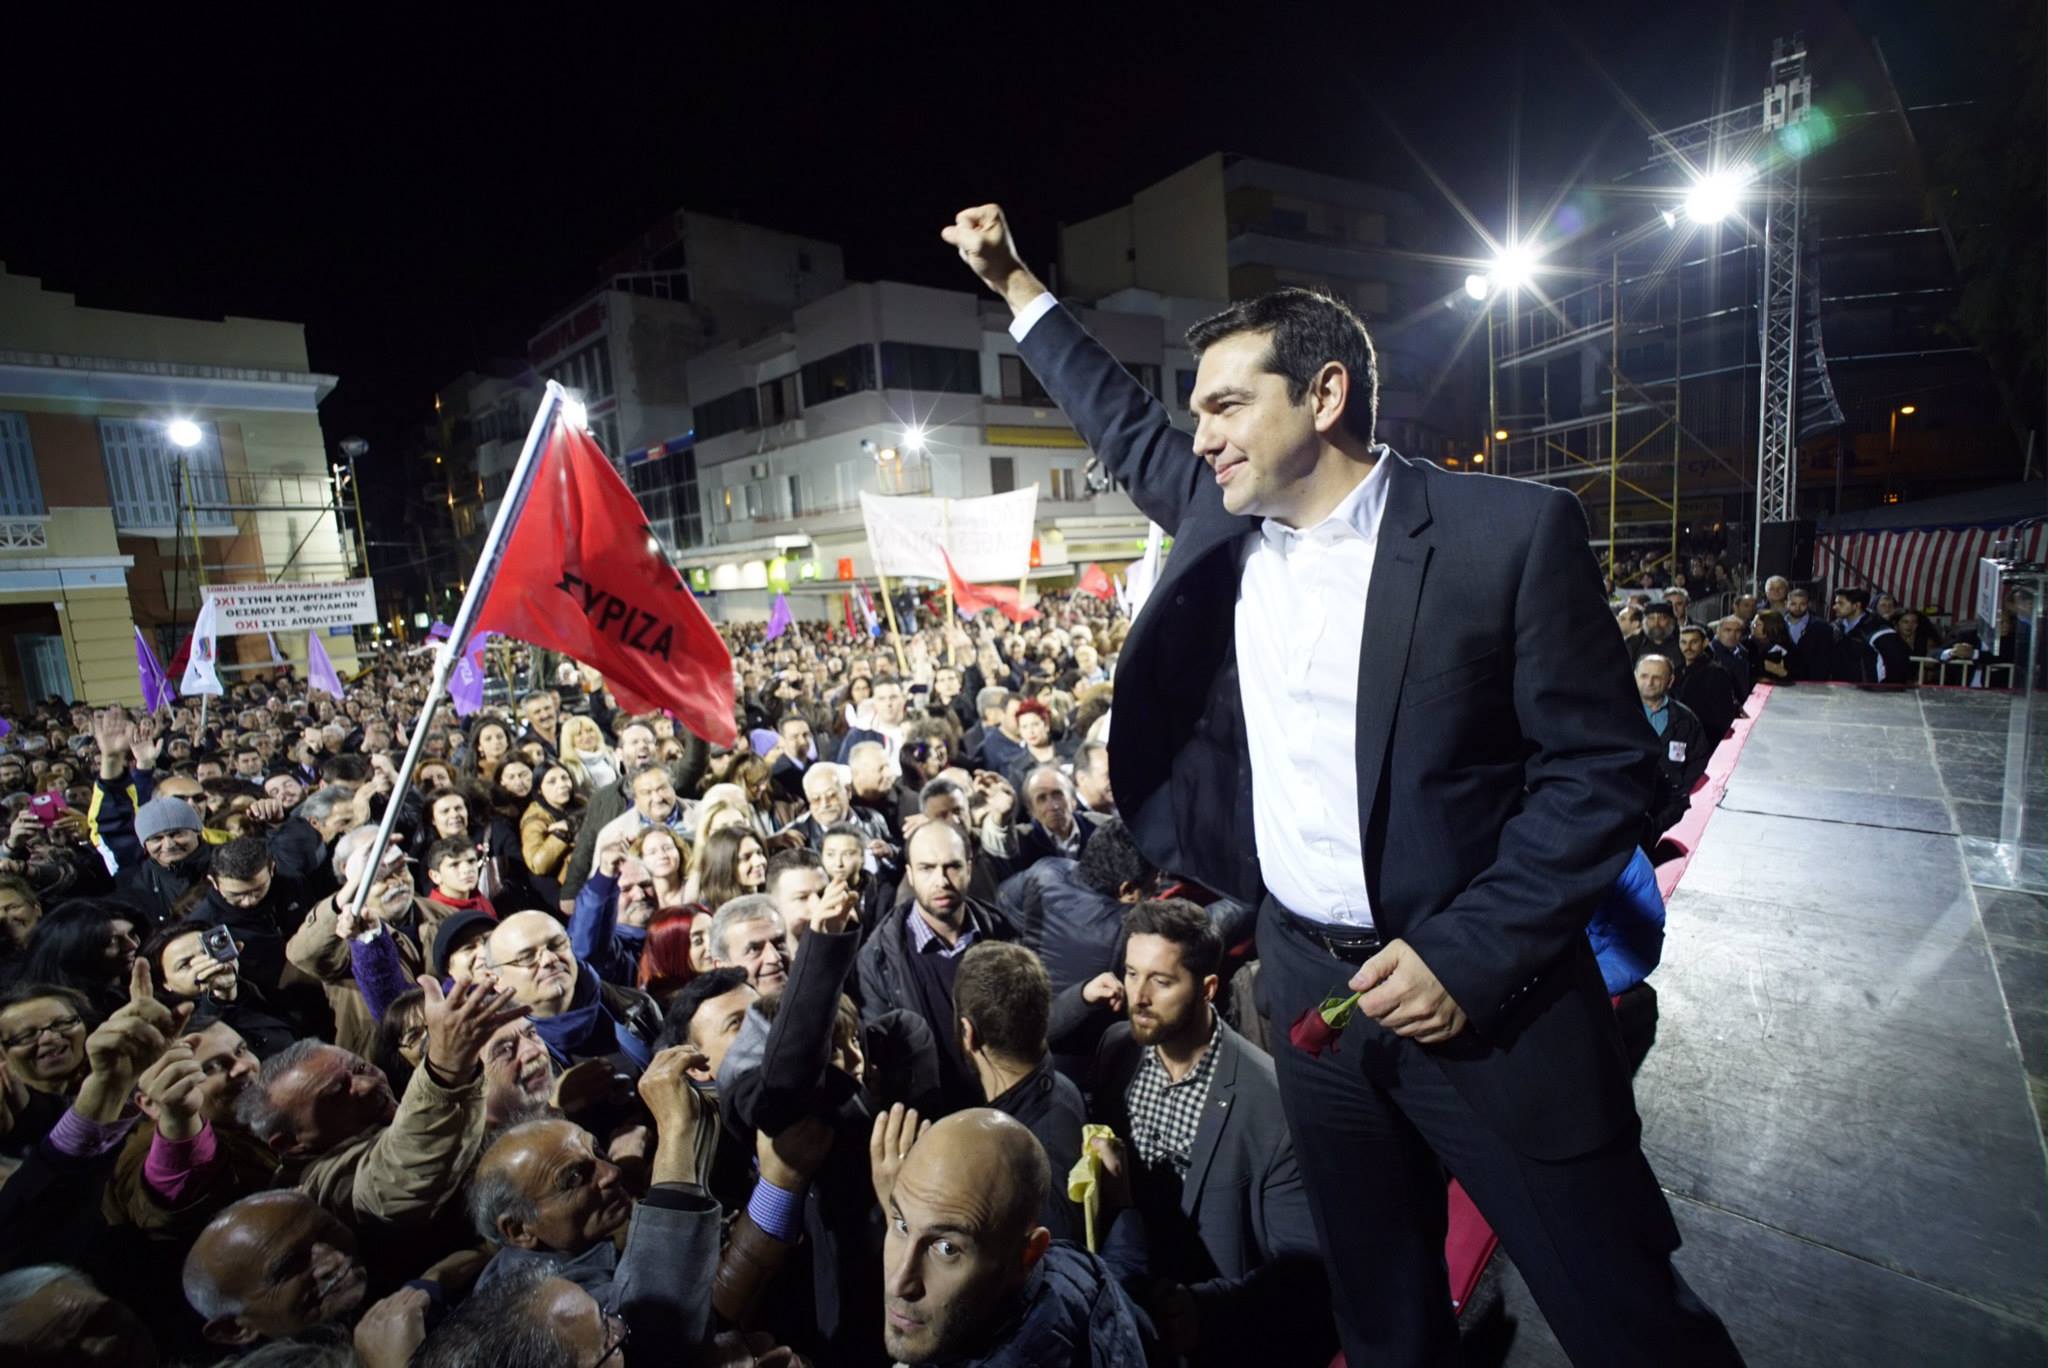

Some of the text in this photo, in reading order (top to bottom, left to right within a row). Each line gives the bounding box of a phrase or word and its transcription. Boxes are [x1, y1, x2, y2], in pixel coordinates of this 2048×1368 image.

[239, 595, 272, 605] ΣΤΗΝ
[275, 591, 342, 603] ΚΑΤΑΡΓΗΣΗ
[346, 590, 366, 598] ΤΟΥ
[225, 606, 276, 617] ΘΕΣΜΟΥ
[303, 601, 358, 612] ΦΥΛΑΚΩΝ
[235, 613, 353, 630] ΟΧΙ ΣΤΙΣ ΑΠΟΛΥΣΕΙΣ
